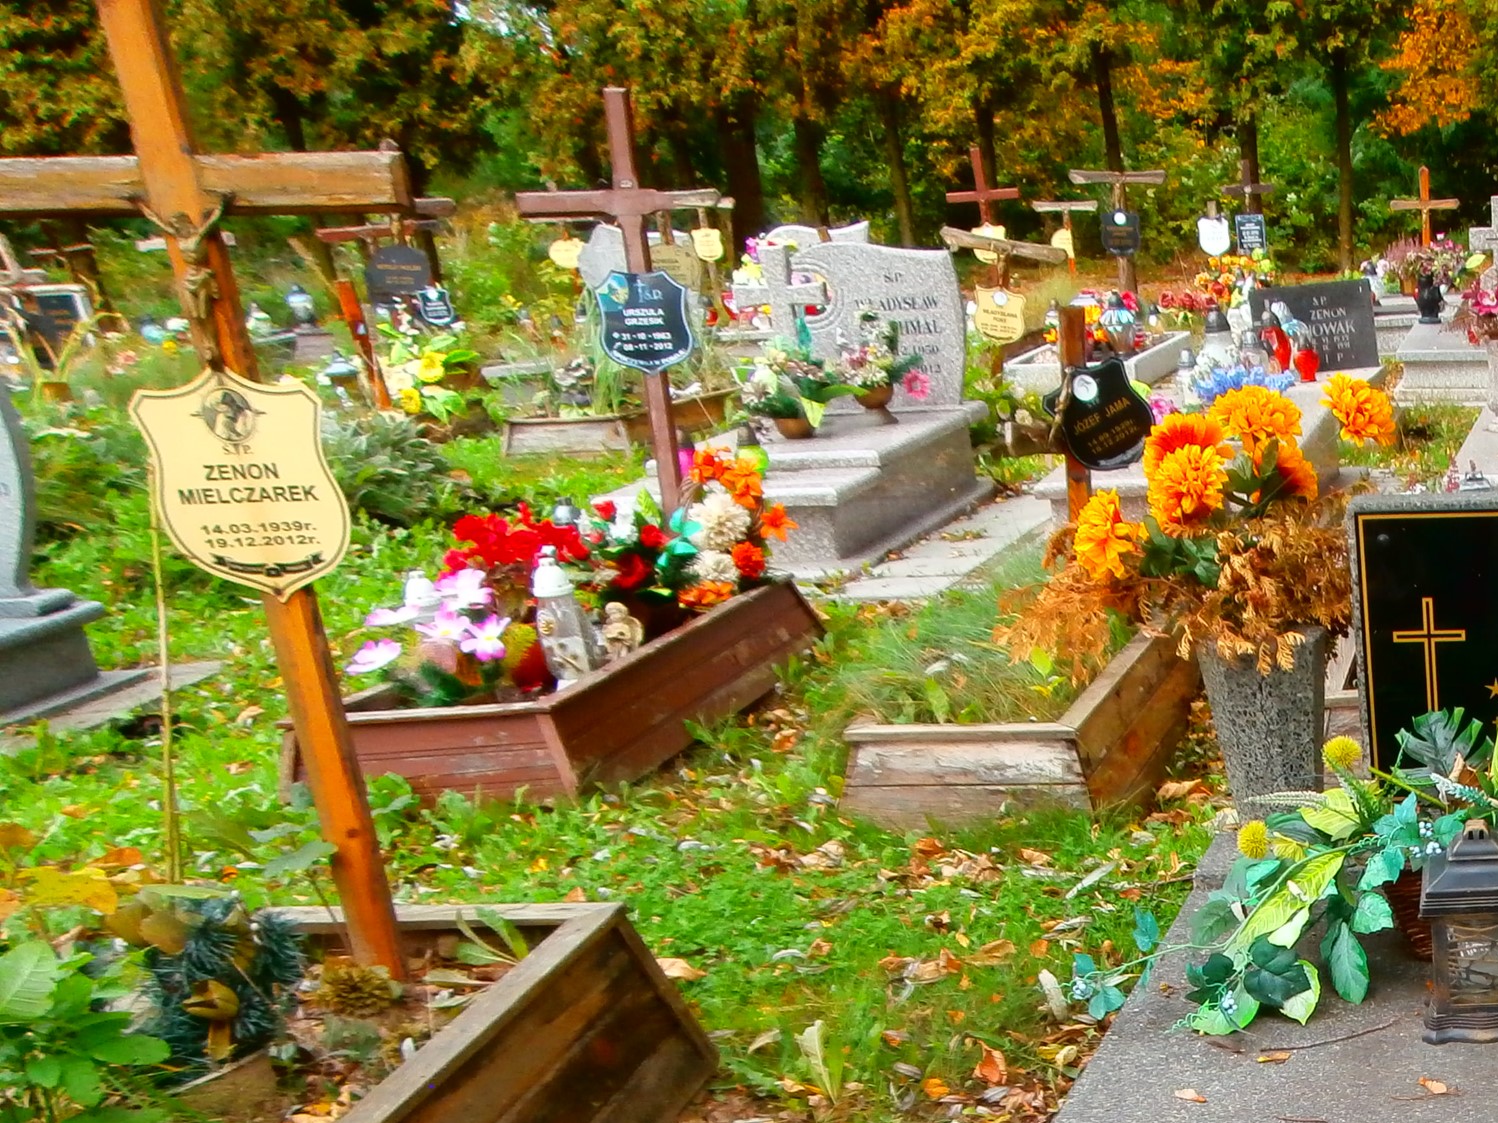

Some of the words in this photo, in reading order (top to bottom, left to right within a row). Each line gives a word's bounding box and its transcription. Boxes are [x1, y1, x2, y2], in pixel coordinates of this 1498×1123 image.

[623, 308, 665, 317] URSZULA
[1309, 307, 1347, 321] ZENON
[1073, 411, 1101, 436] JÓZEF
[1104, 396, 1131, 418] JAMA
[203, 462, 281, 481] ZENON
[178, 485, 320, 505] MIELCZAREK
[200, 521, 318, 536] 14.03.1939r.
[205, 534, 322, 549] 19.12.2012r.
